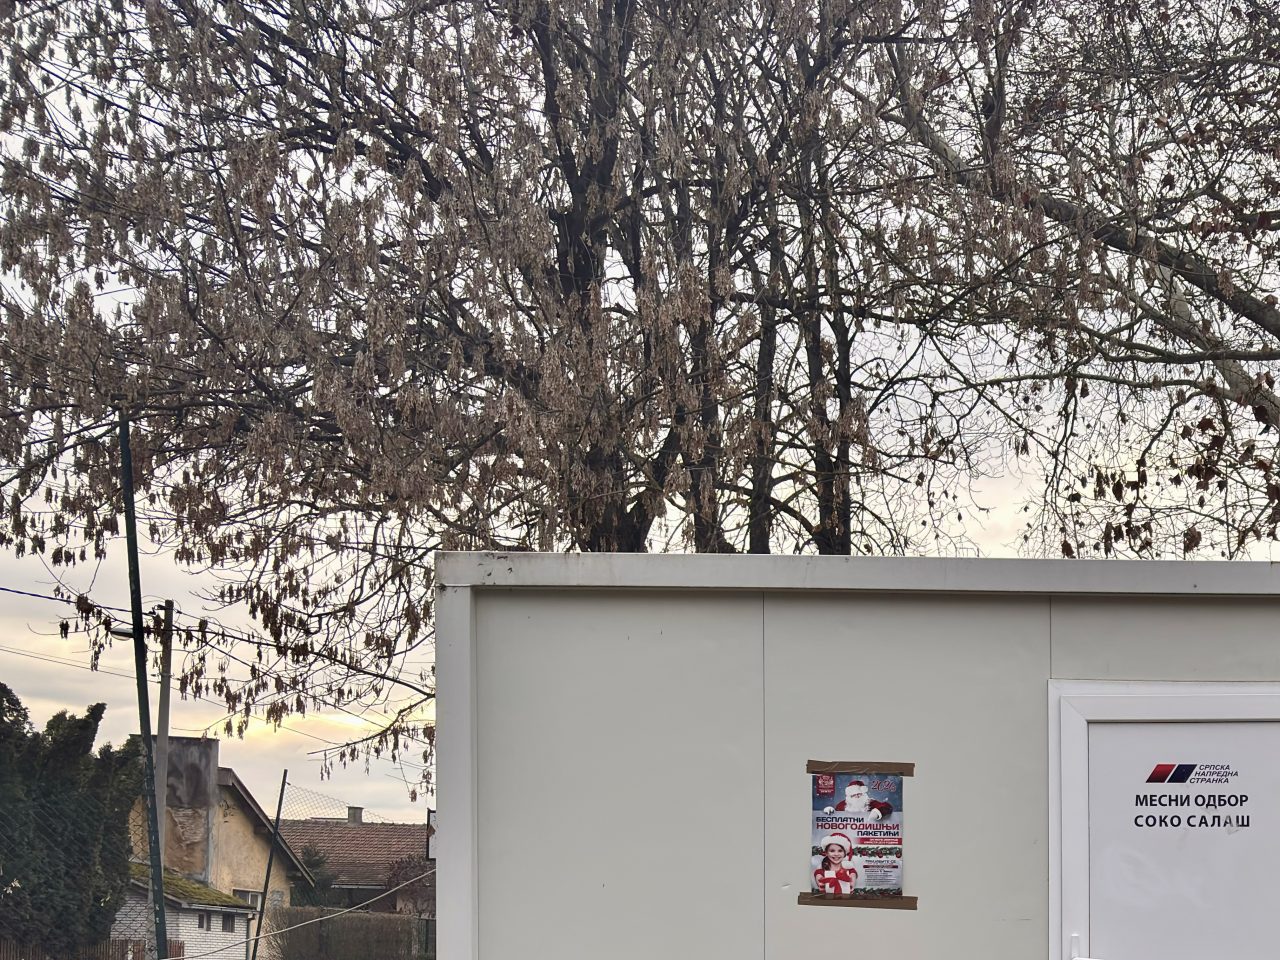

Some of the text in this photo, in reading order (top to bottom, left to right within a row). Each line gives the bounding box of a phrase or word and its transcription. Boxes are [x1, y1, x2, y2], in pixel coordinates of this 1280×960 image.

[1135, 794, 1249, 809] МЕСНИ ОДБОР
[816, 823, 900, 831] НОВОГОДИШЊИ
[1134, 815, 1250, 828] СОКО САЛАШ
